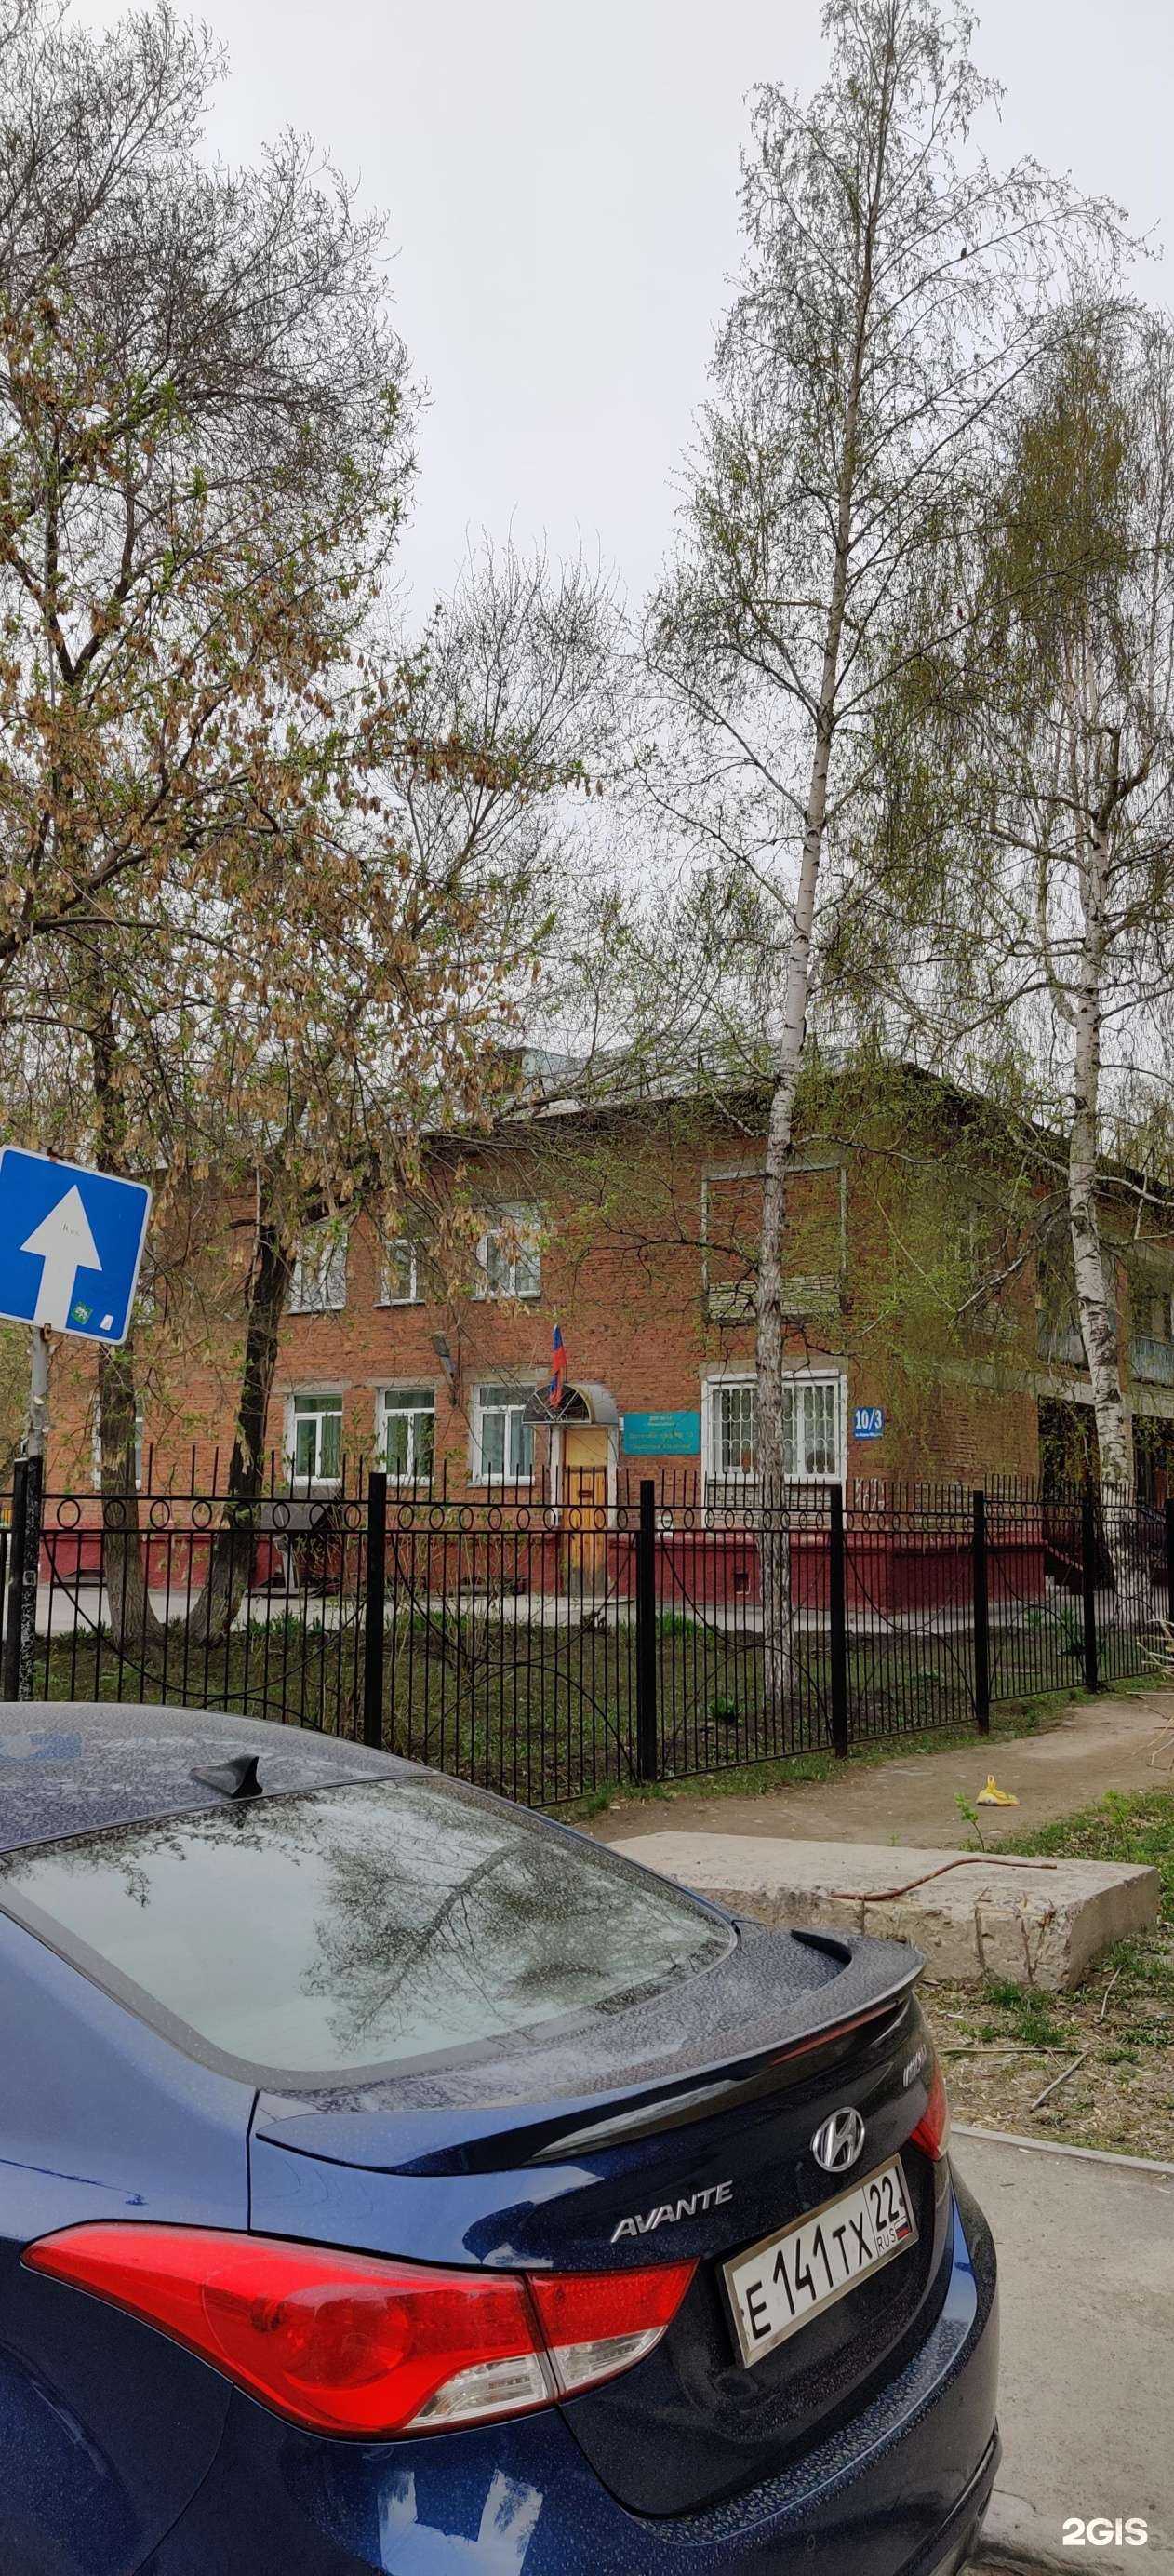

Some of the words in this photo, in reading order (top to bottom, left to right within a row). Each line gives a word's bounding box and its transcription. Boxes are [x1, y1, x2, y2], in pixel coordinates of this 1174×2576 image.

[855, 1408, 883, 1430] 10/3
[610, 2180, 734, 2244] AVANTE
[870, 2176, 900, 2233] 22
[876, 2227, 896, 2251] RUS
